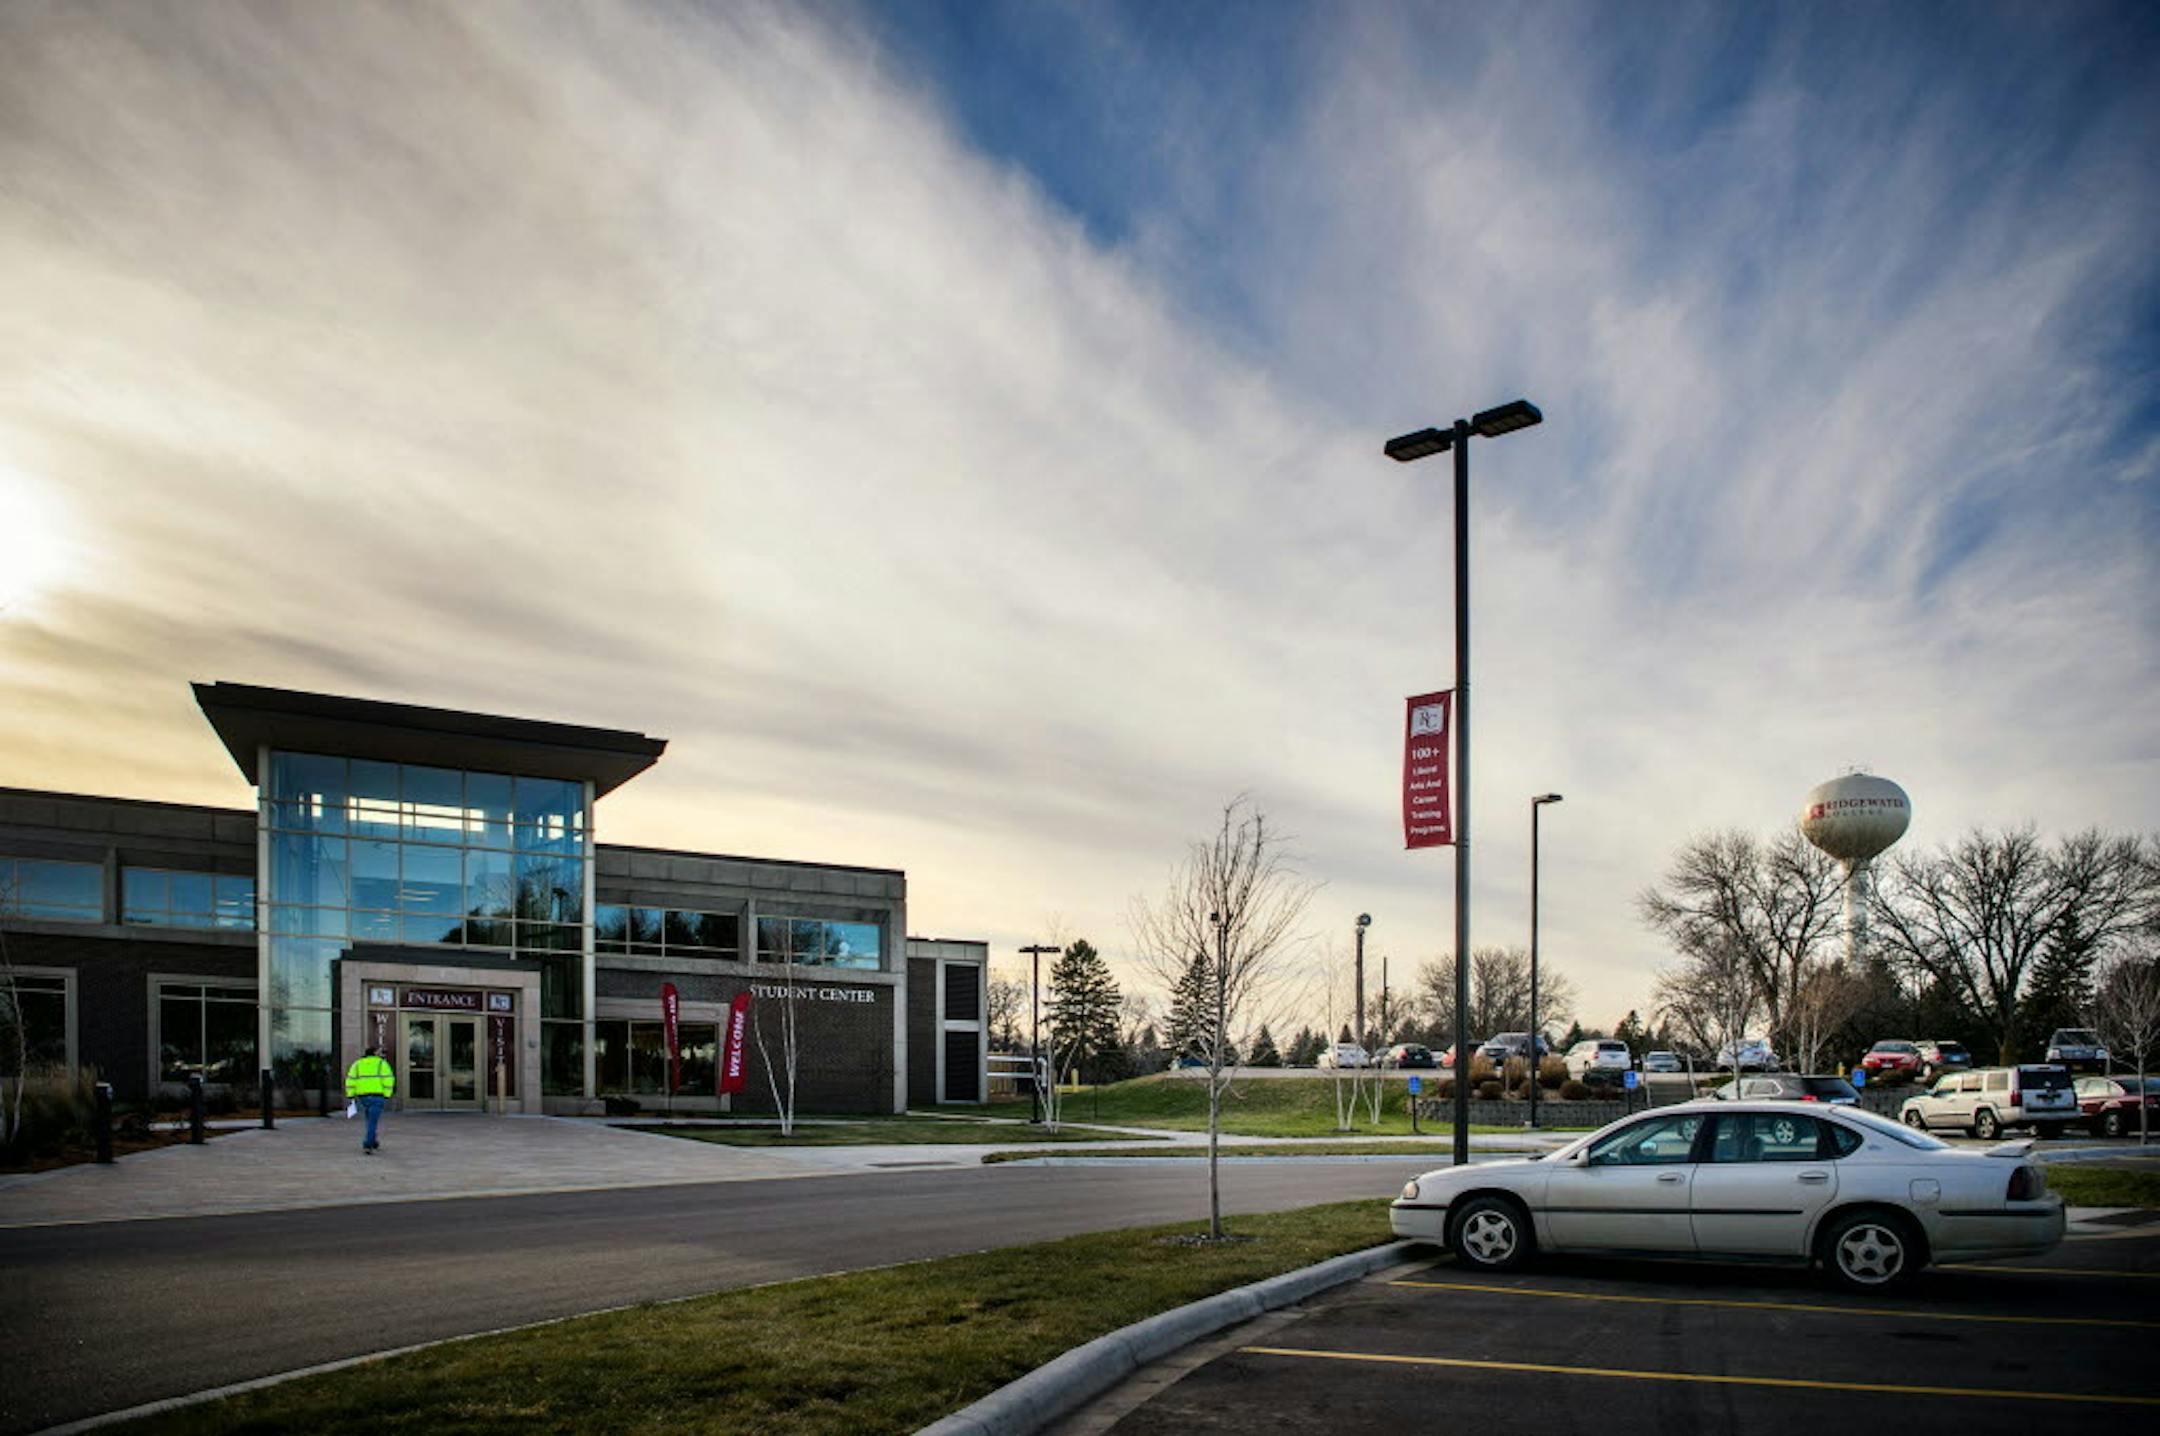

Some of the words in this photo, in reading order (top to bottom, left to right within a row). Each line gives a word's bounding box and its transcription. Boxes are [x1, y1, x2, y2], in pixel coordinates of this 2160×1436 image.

[1412, 748, 1440, 760] 100+
[408, 992, 476, 1007] ENTRANCE
[750, 984, 817, 1001] STUDENT
[819, 988, 875, 1003] CENTER
